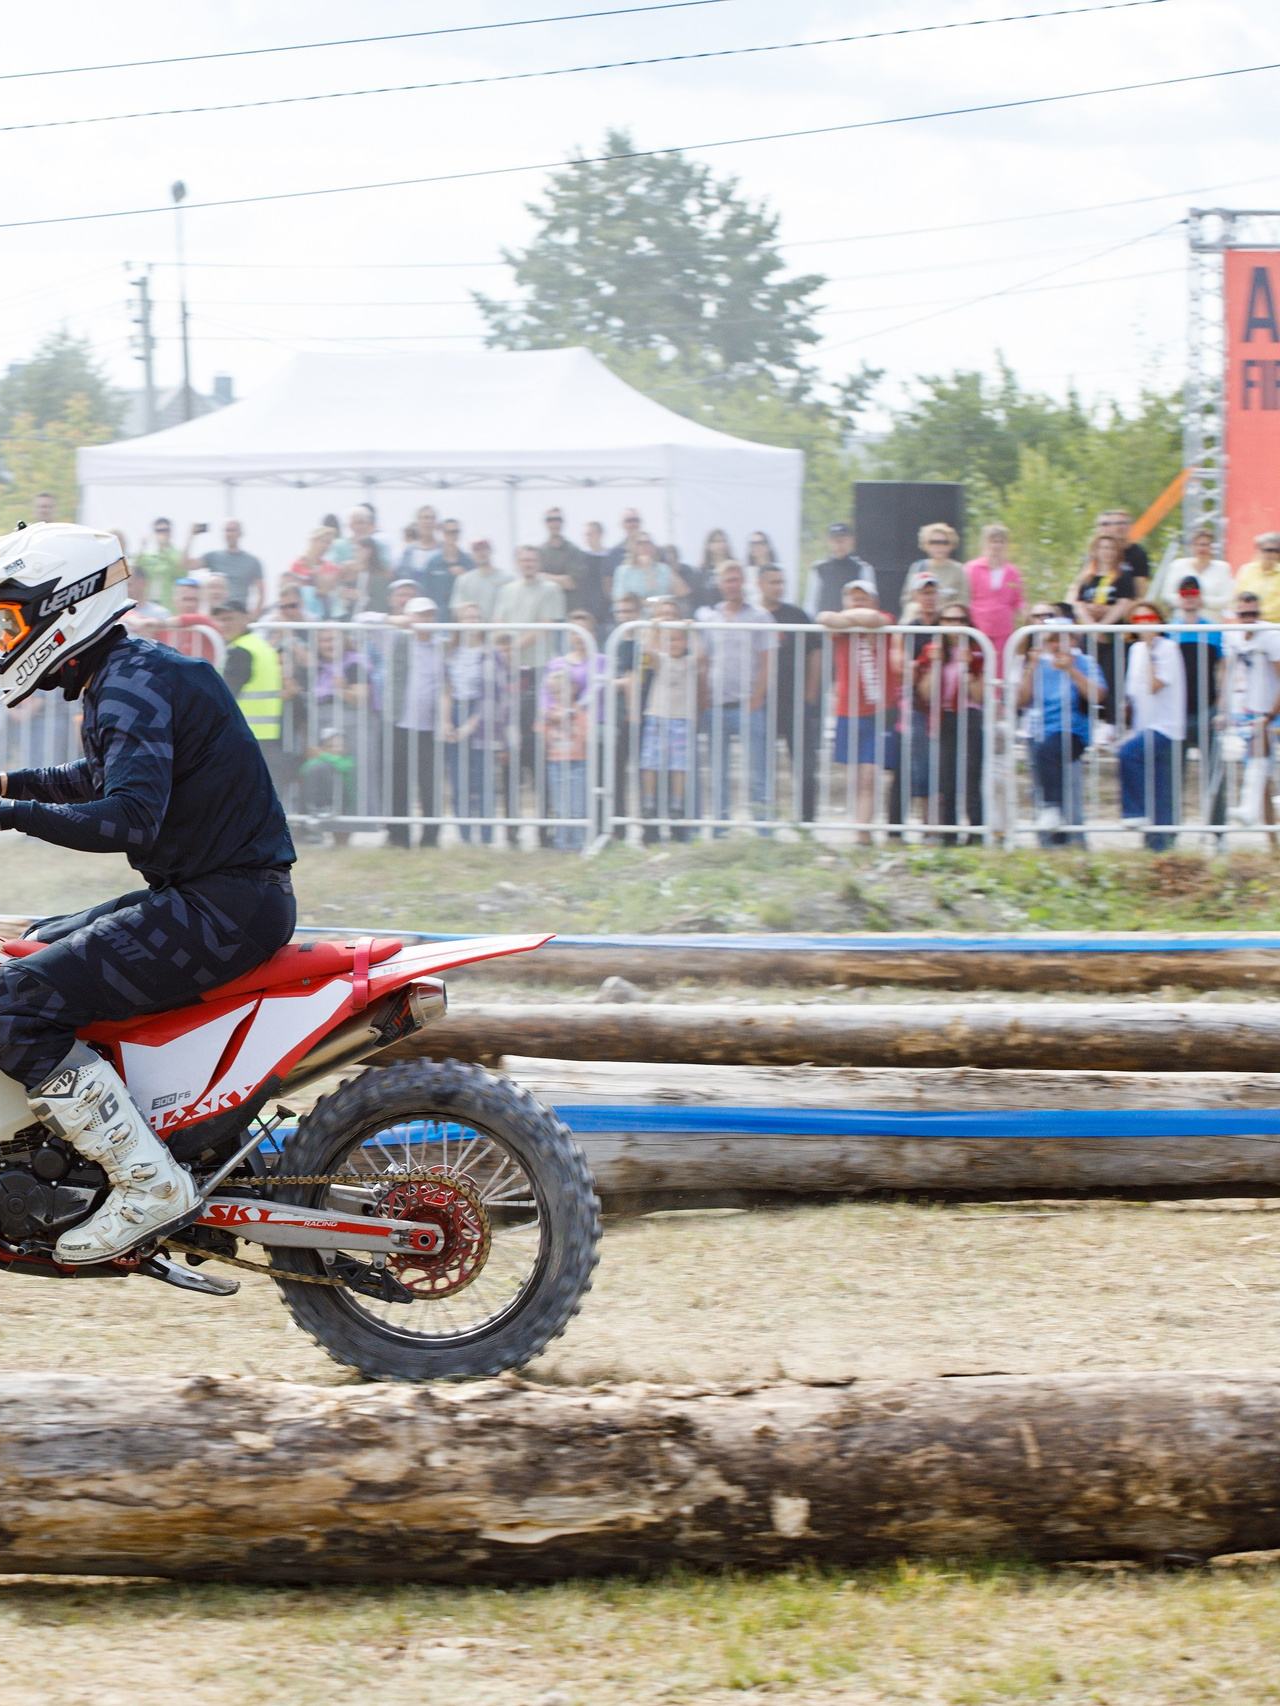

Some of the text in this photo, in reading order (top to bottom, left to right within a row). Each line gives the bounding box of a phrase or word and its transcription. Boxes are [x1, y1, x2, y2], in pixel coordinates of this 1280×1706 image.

[38, 572, 102, 617] LEATT
[15, 628, 67, 686] JUST1
[153, 1090, 191, 1108] 300 F6
